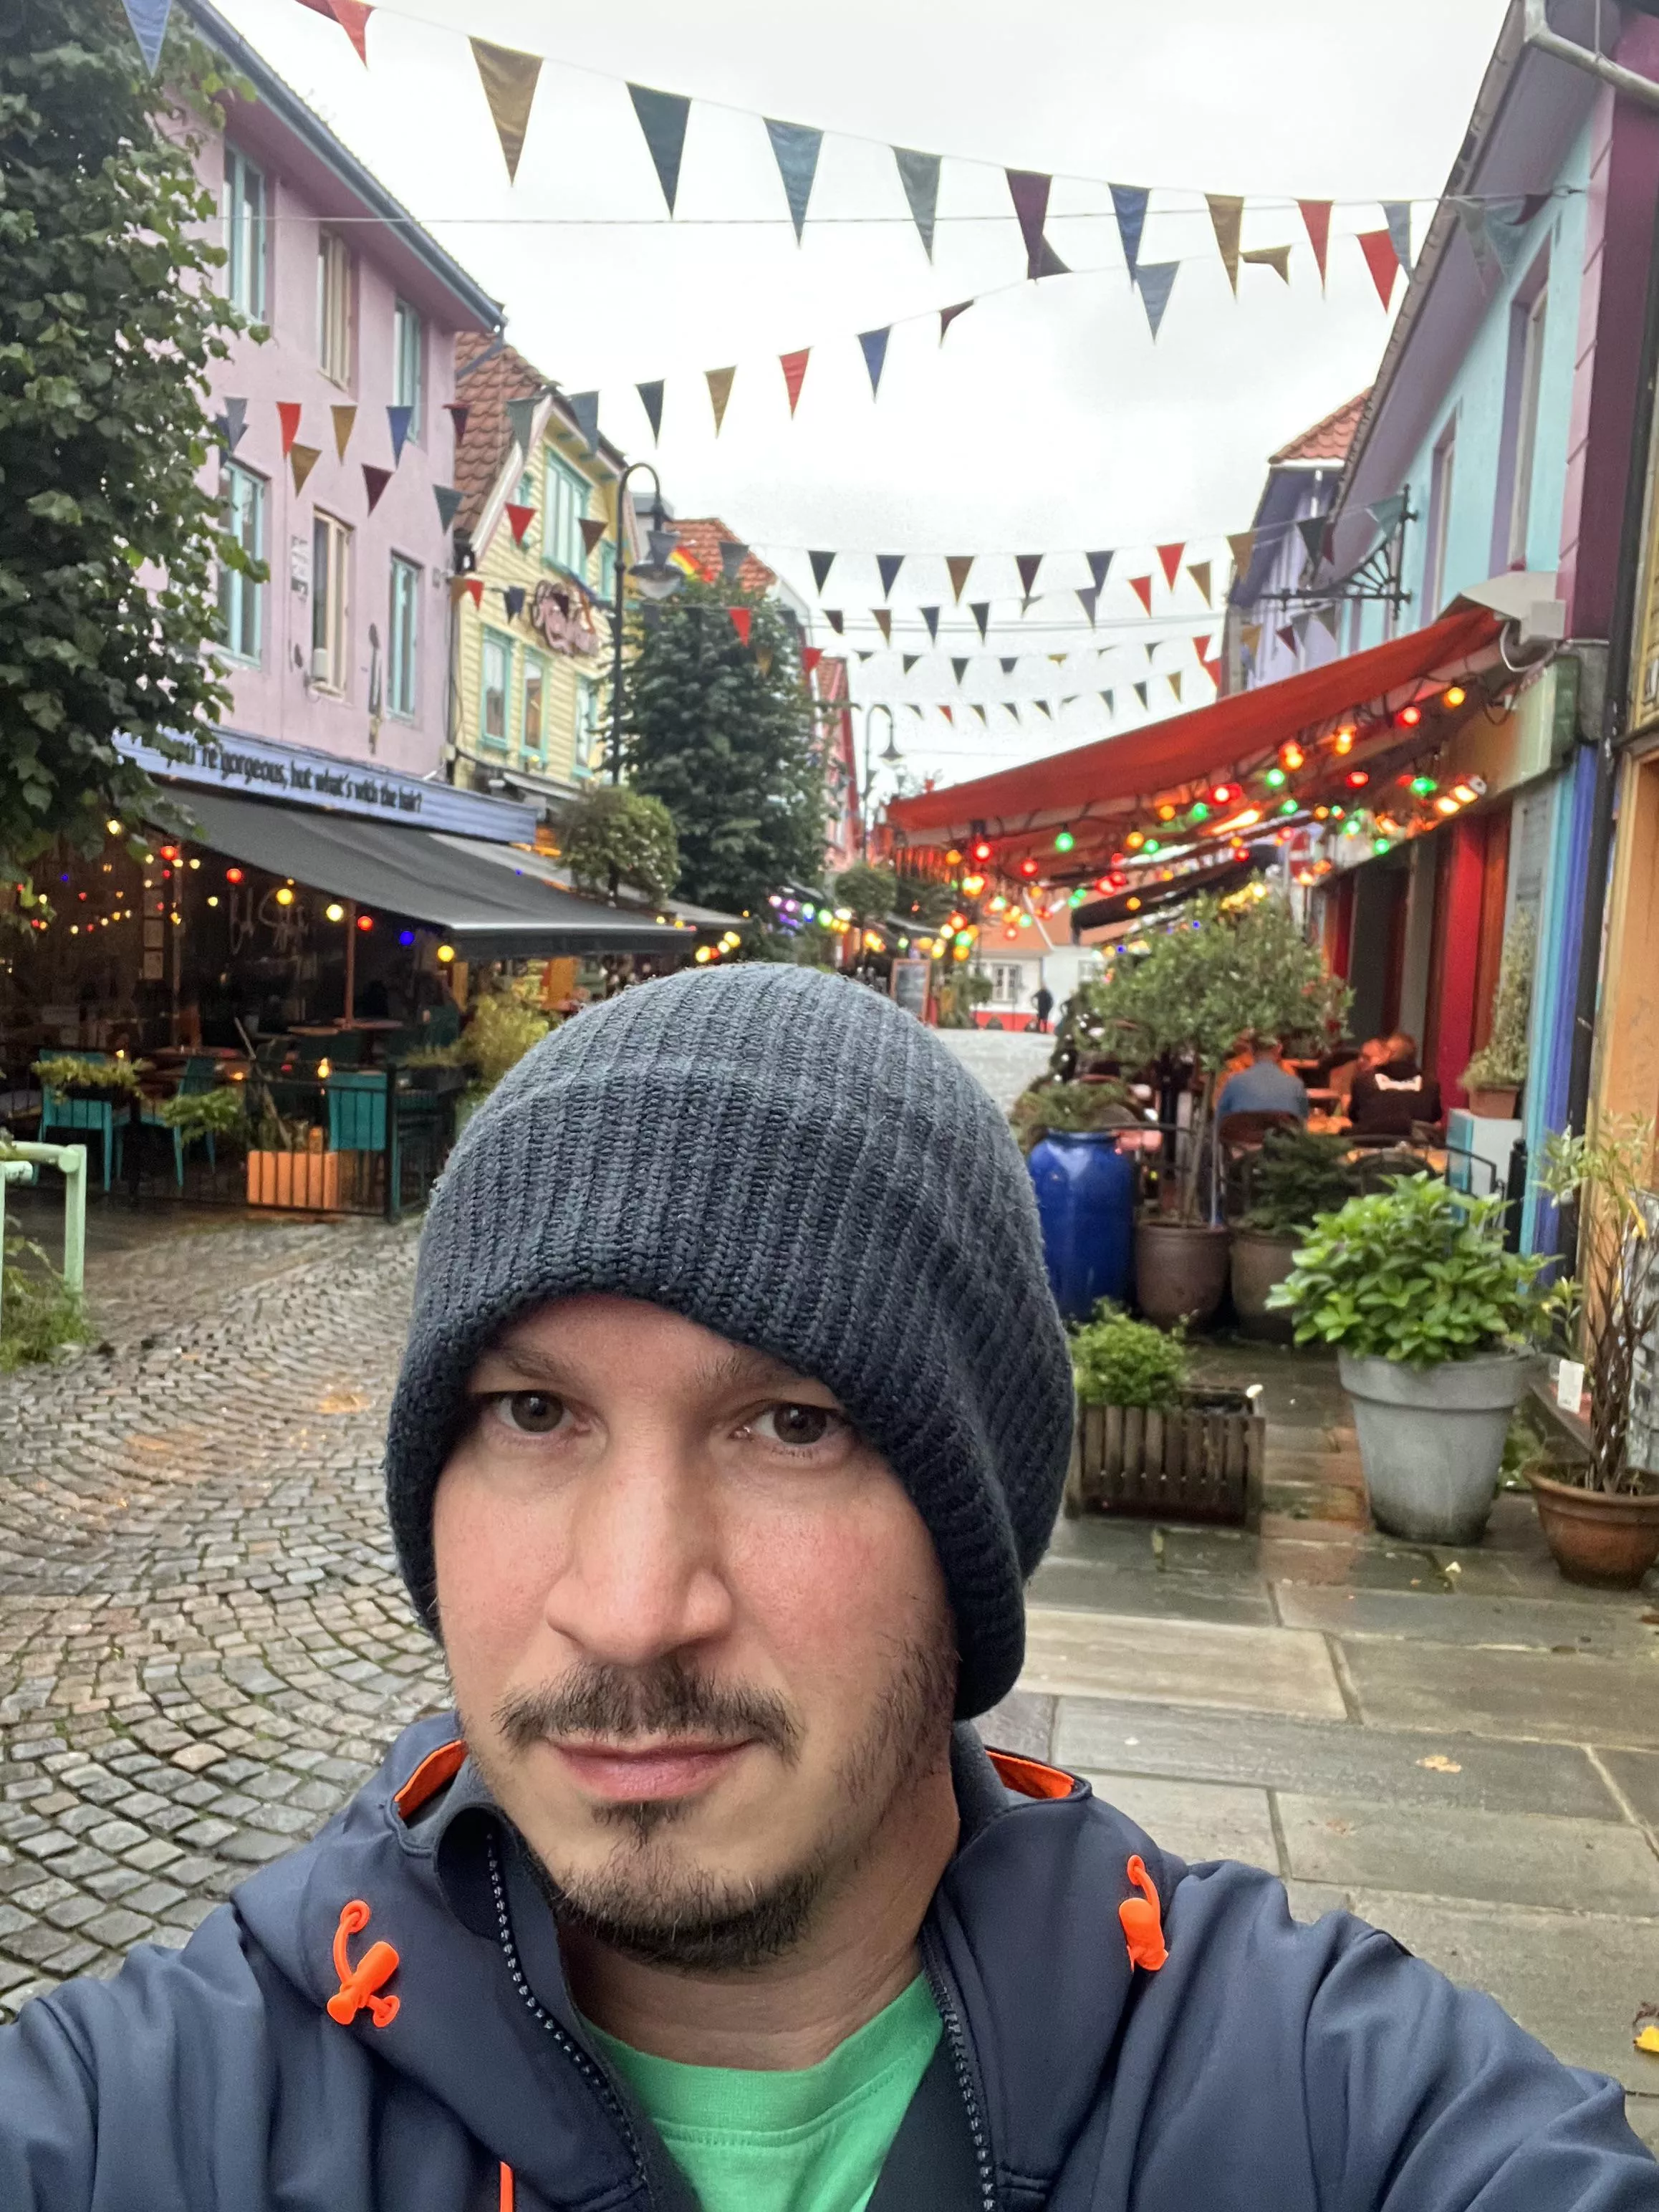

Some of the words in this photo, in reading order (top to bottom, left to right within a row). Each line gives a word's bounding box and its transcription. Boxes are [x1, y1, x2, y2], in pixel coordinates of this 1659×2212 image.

[221, 753, 287, 790] gorgeous,
[291, 759, 311, 790] but
[355, 779, 378, 803] with
[381, 781, 396, 807] the
